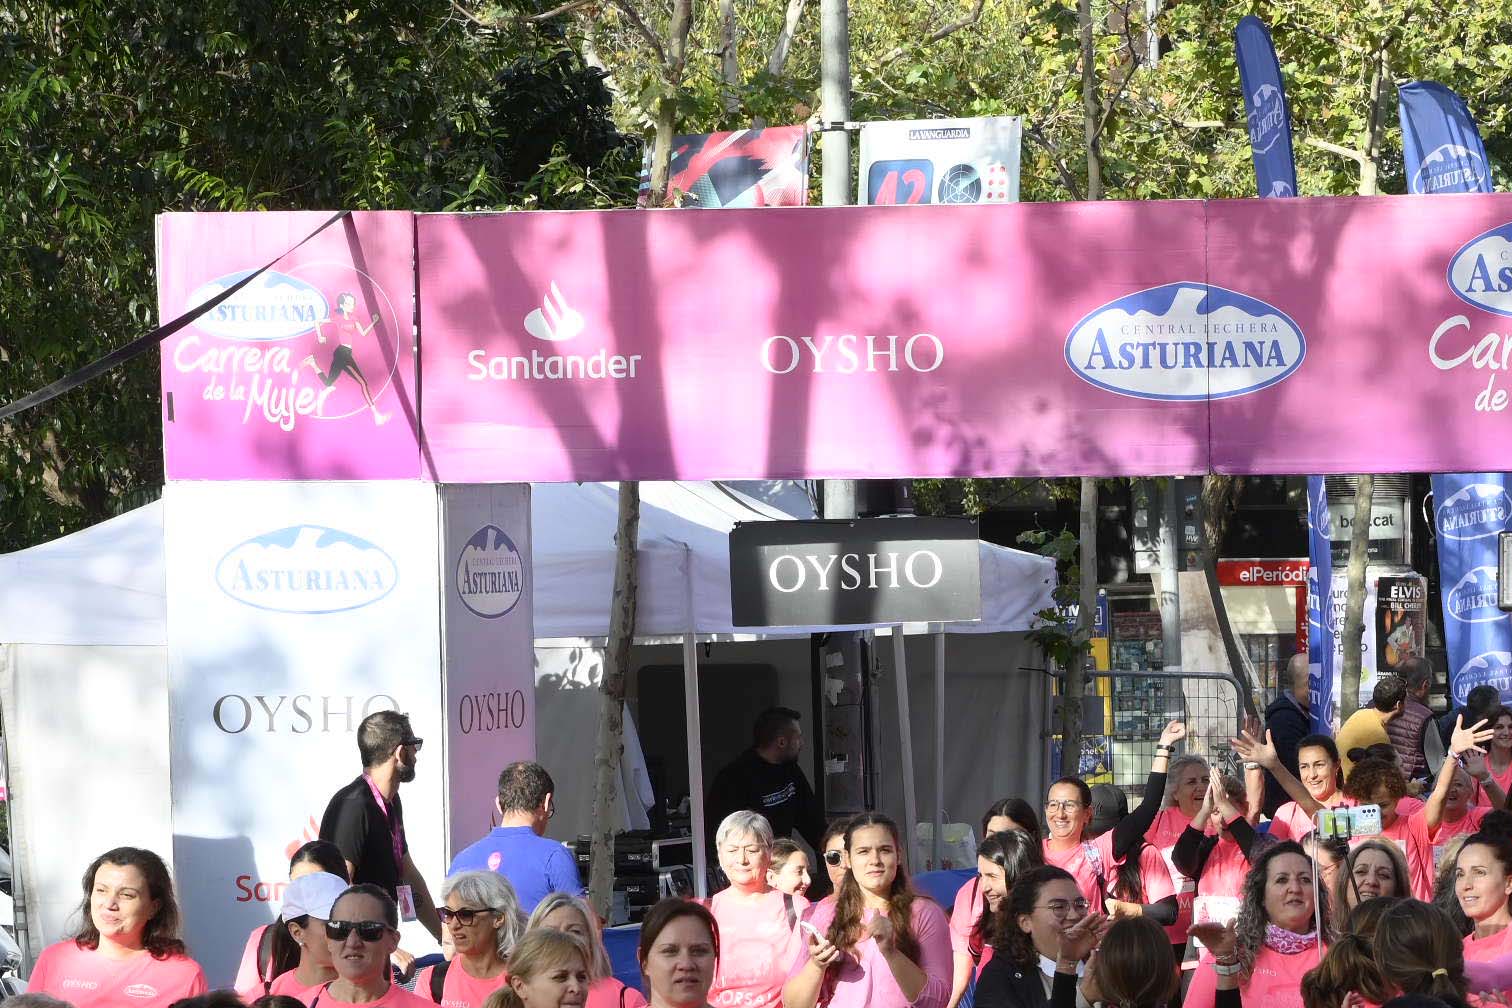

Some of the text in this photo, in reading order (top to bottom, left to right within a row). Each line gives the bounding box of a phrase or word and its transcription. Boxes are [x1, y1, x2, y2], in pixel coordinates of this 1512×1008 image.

[911, 128, 969, 139] LA VANGUARDIA
[1121, 322, 1279, 335] CENTRAL LECHERA
[173, 336, 289, 373] Carrera
[468, 348, 642, 381] Santander
[760, 334, 943, 374] OYSHO
[1084, 327, 1288, 371] ASTURIANA
[203, 371, 336, 432] de la Mujer
[1475, 374, 1507, 411] de
[231, 560, 384, 591] ASTURIANA
[462, 564, 520, 595] ASTURIANA
[769, 550, 943, 593] OYSHO
[1390, 585, 1421, 598] ELVIS
[459, 690, 525, 734] OYSHO
